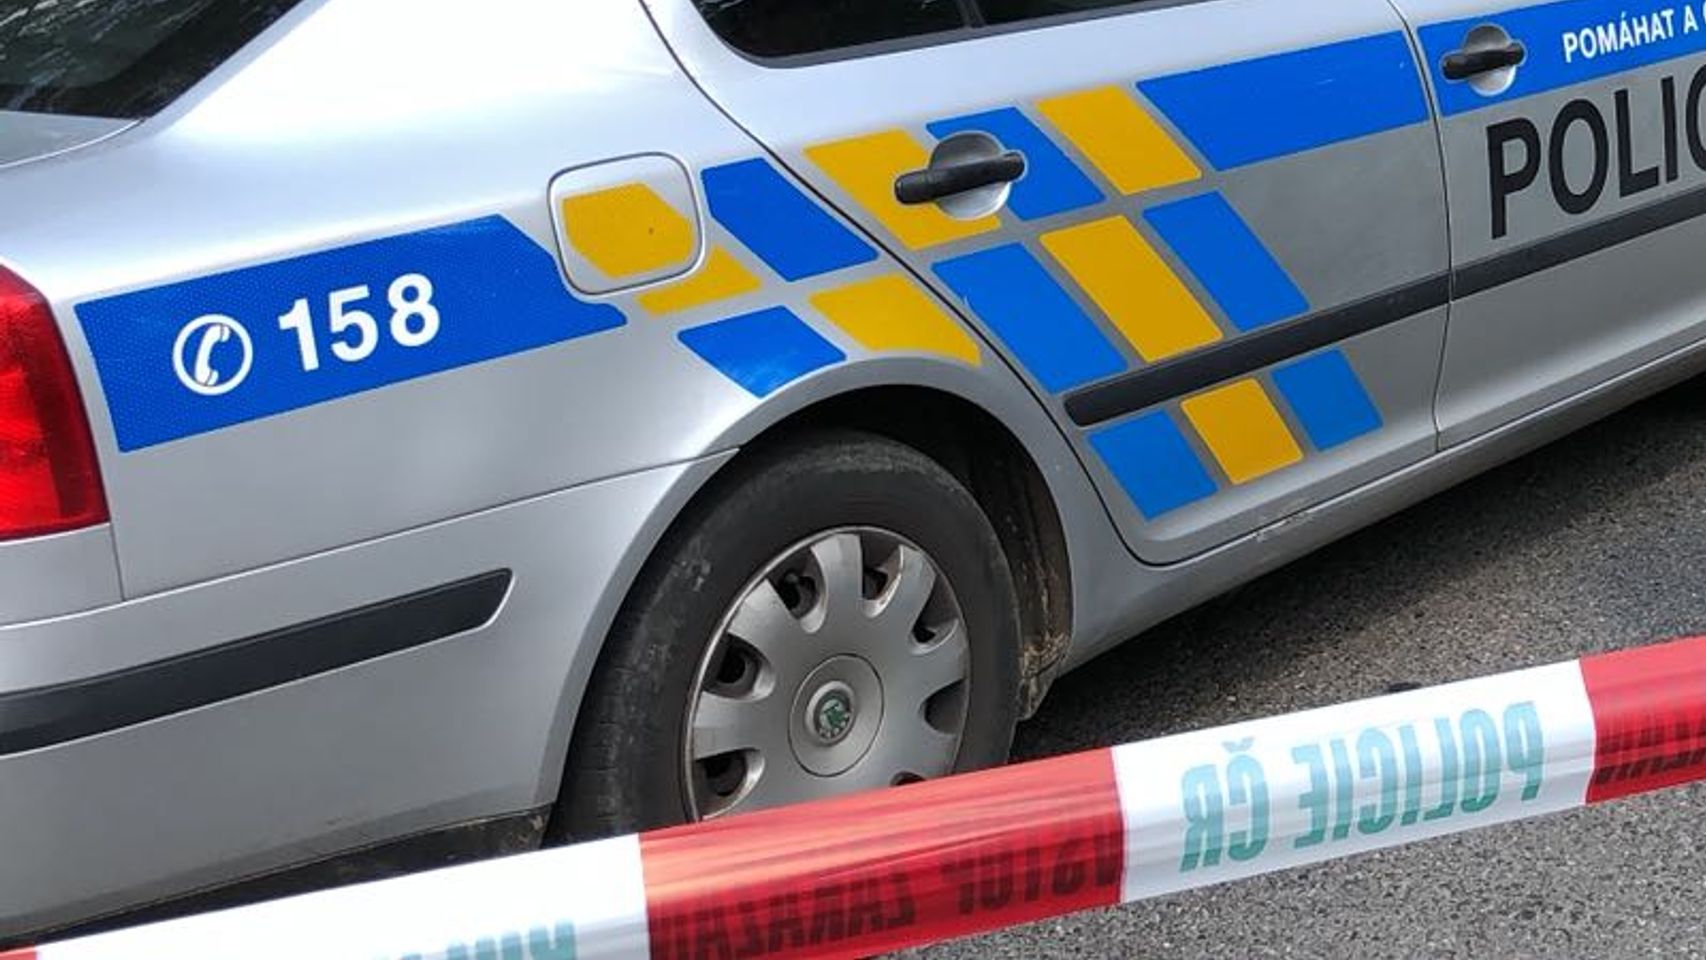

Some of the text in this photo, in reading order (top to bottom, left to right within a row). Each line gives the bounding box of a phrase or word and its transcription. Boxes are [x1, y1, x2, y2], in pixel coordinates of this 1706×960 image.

[1562, 9, 1675, 63] POMÁHAT
[1683, 4, 1699, 35] A
[277, 273, 441, 372] 158
